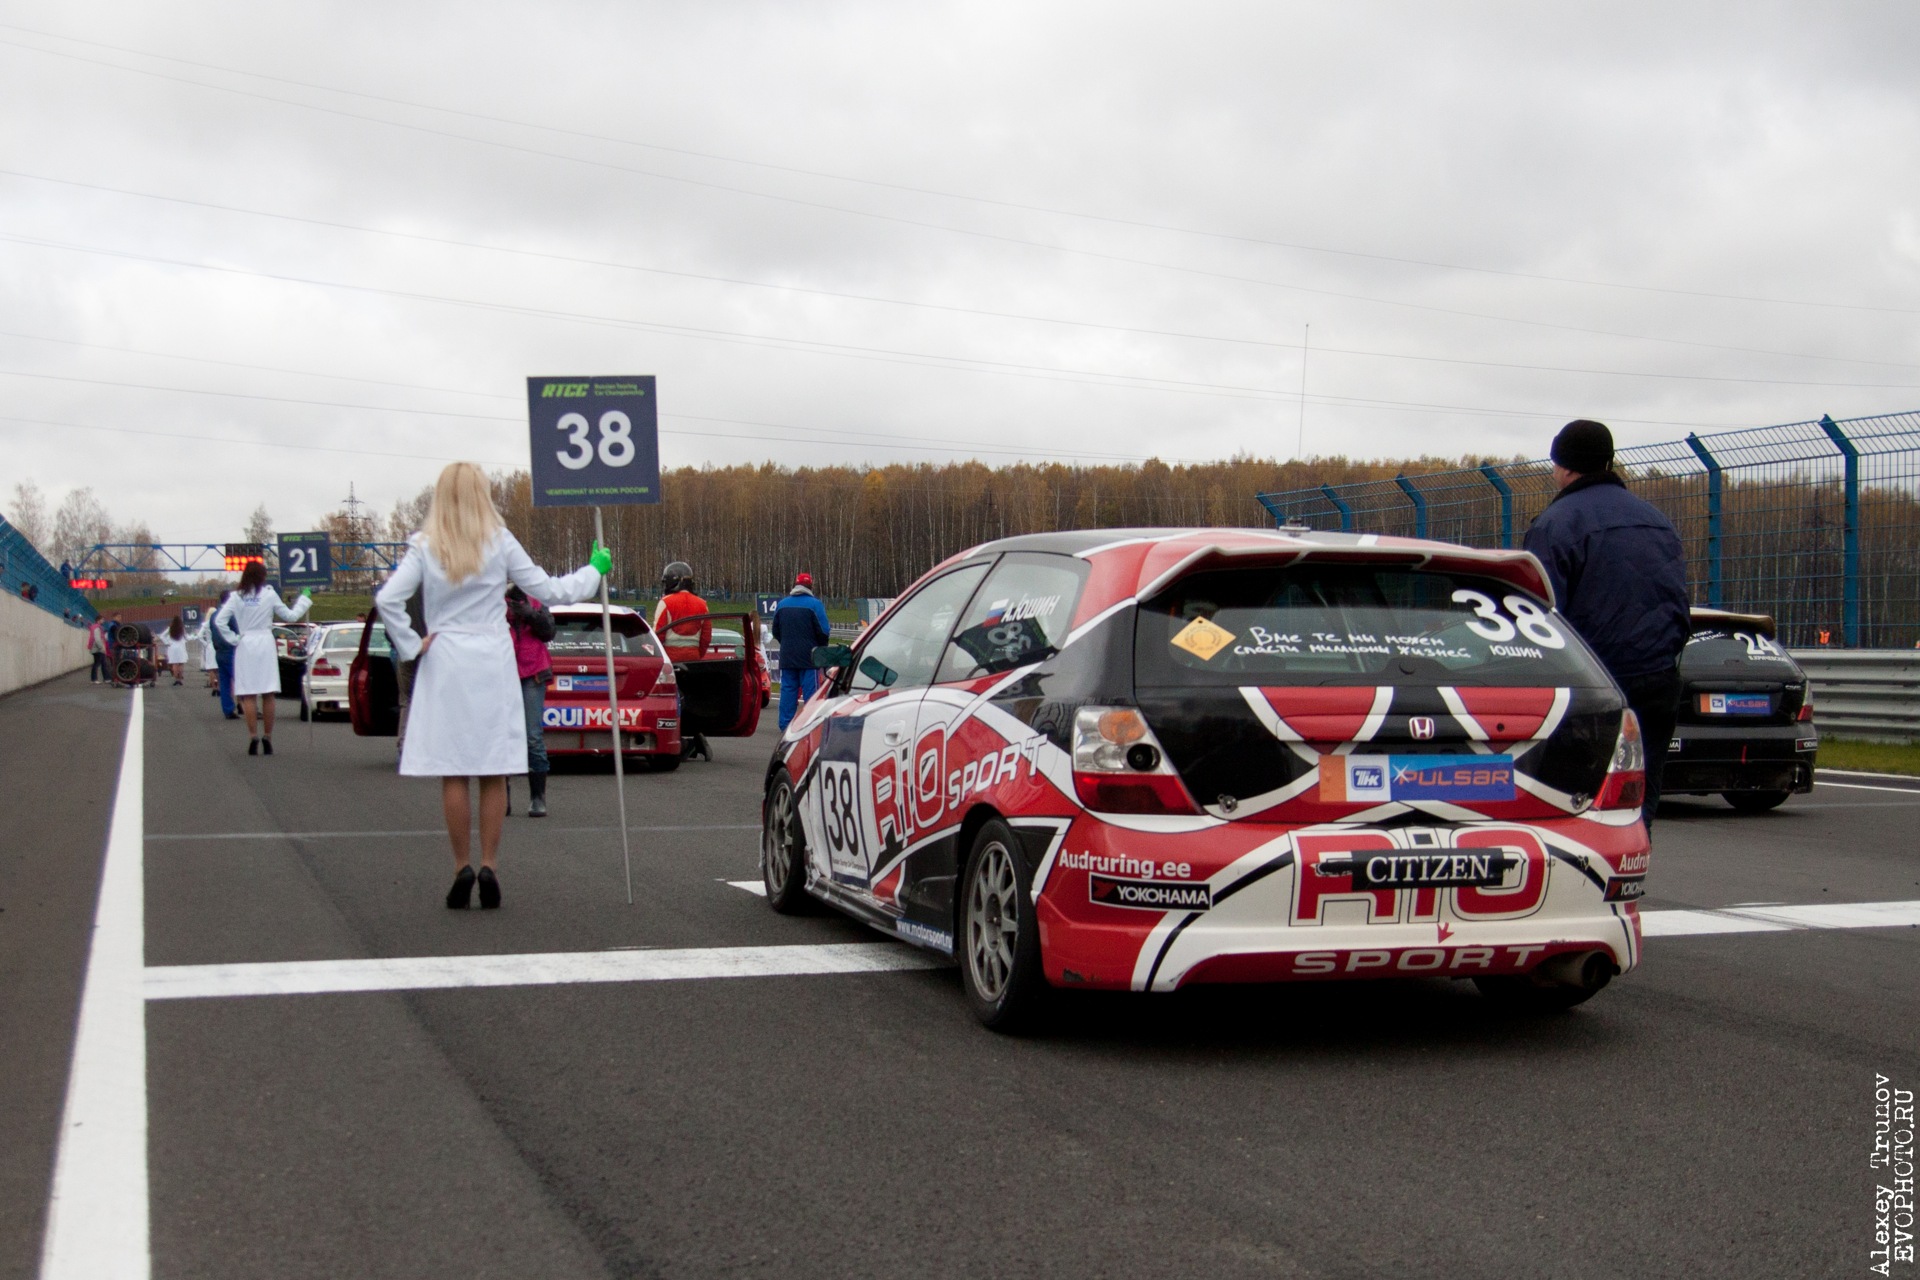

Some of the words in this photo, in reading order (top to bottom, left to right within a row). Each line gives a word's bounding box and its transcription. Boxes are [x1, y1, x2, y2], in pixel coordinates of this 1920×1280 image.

[541, 383, 590, 398] RTCC
[556, 410, 636, 470] 38
[289, 548, 318, 573] 21
[186, 609, 198, 620] 10
[762, 600, 778, 614] 14
[1451, 589, 1566, 650] 38
[1489, 645, 1543, 659] ЮШИН
[1733, 632, 1779, 656] 24
[585, 708, 641, 726] MOLY
[948, 734, 1048, 810] SPORT
[825, 767, 859, 856] 38
[1058, 849, 1191, 879] Audruring.ee
[1366, 854, 1491, 883] CITIZEN
[1117, 885, 1209, 904] YOKOHAMA
[1292, 945, 1546, 974] SPORT
